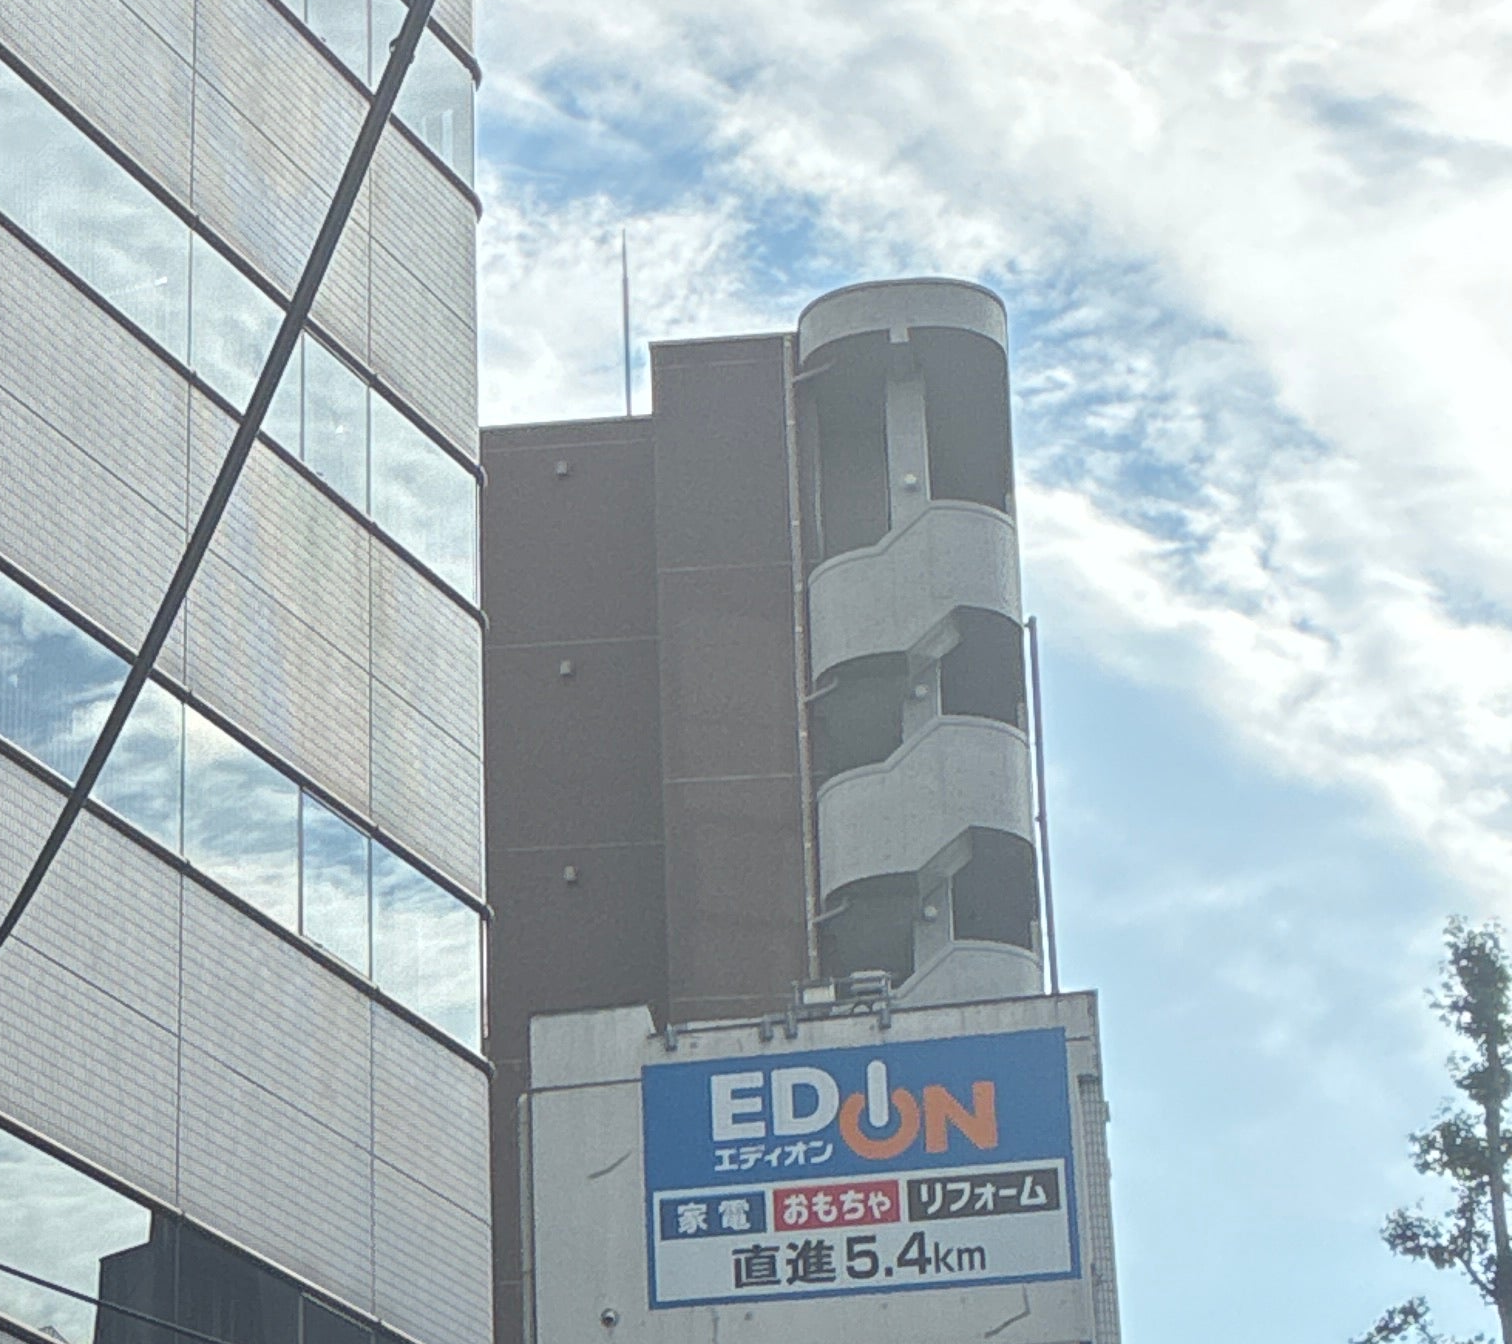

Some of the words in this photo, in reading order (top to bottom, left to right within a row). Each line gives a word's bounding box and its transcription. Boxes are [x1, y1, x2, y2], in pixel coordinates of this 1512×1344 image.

[710, 1059, 999, 1160] EDION
[714, 1140, 834, 1173] エディオン
[676, 1199, 753, 1235] 家電
[782, 1189, 893, 1227] おもちゃ
[919, 1175, 1049, 1214] リフォーム
[731, 1231, 987, 1290] 直進5.4km
